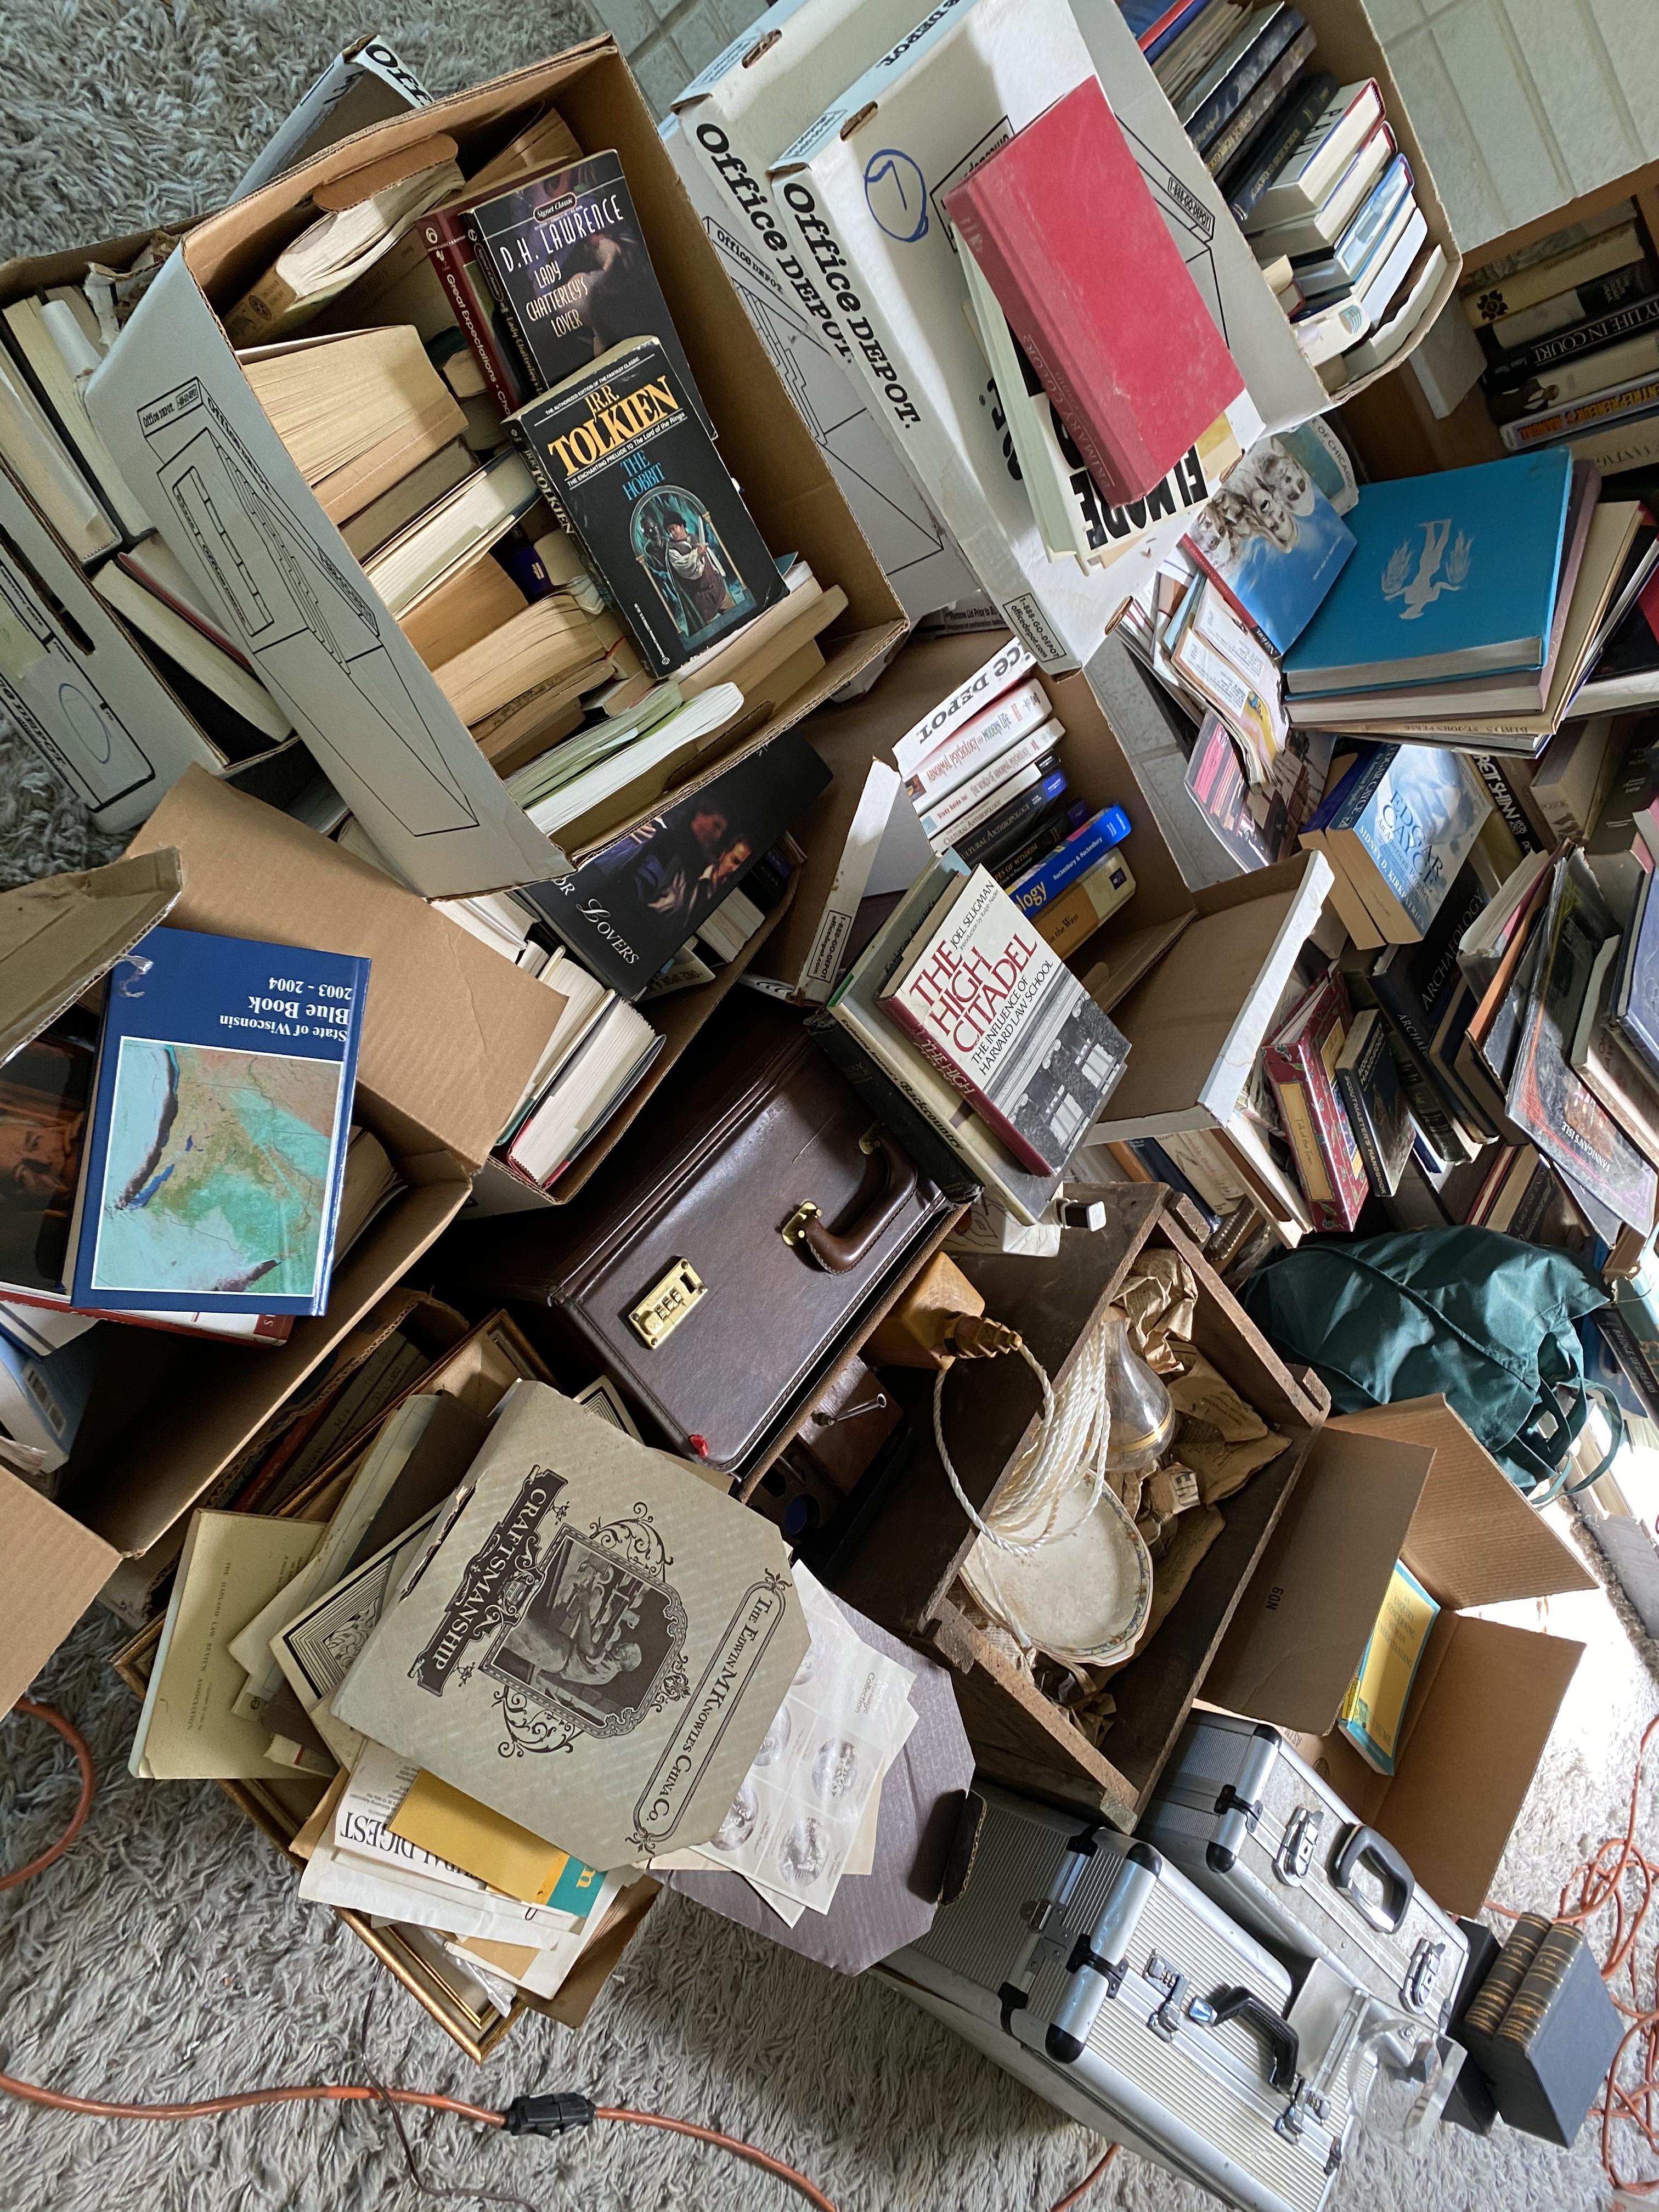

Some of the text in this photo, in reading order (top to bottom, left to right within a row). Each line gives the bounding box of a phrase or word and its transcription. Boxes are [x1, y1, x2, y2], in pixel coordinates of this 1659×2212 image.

[365, 44, 432, 106] Off
[537, 197, 573, 218] Signet Classic
[1169, 179, 1211, 228] 1-888-GO-DEPOT
[500, 194, 624, 272] D.H. LAWRENCE
[696, 122, 788, 253] Office
[776, 255, 853, 364] DEPOT.
[716, 229, 752, 266] Office
[526, 276, 589, 322] CHATTERLEY'S
[534, 261, 562, 289] LADY
[447, 274, 497, 383] Great Expectations
[506, 316, 520, 338] Lady
[551, 308, 583, 338] LOVER
[783, 182, 862, 313] Office
[847, 315, 921, 431] DEPOT.
[1535, 311, 1644, 363] LIFE IN COURT
[554, 393, 579, 411] AUTHORIZED
[578, 385, 594, 397] EDITION
[592, 380, 599, 388] OF
[598, 376, 606, 385] THE
[606, 365, 625, 381] FANTASY
[623, 356, 640, 370] CLASSIC
[142, 411, 160, 428] Office
[547, 375, 680, 477] TOLKIEN
[1022, 334, 1111, 489] PRIMARY COLORS
[1520, 411, 1566, 440] MANUAL
[567, 412, 686, 488] THE ENCHANTING PRELUDE TO The Lord of the Rings
[620, 449, 650, 477] THE
[1318, 426, 1353, 489] OF CHICAGO
[532, 466, 574, 534] TOLKIEN
[622, 462, 666, 501] HOBBIT
[1011, 605, 1048, 658] officedepot.com
[1020, 597, 1060, 658] 1-888-GO-DEPOT
[926, 753, 953, 785] ABNORMAL
[951, 736, 980, 768] PSYCHOLOGY
[983, 723, 1003, 742] MODERN
[1000, 712, 1012, 730] LIFE
[938, 808, 950, 819] Study
[950, 798, 962, 811] Guide
[943, 820, 969, 846] CULTURAL
[967, 799, 1002, 829] ANTHROPOLOGY
[988, 802, 1031, 842] ANTHROPOLOGY
[1355, 780, 1376, 815] CAYCE
[1014, 843, 1039, 865] WISDOM
[1052, 860, 1077, 881] Hockenbury
[1079, 837, 1103, 859] Hockenbury
[1377, 818, 1430, 900] An American Prophet
[1383, 804, 1438, 892] CAYCE
[1389, 789, 1443, 877] EDGAR
[1359, 825, 1426, 932] SIDNEY D. KIRKPATRICK
[575, 898, 640, 964] LOVERS
[950, 880, 994, 949] JOEL SELIGMAN
[960, 889, 999, 951] Introduction by Ralph Nader
[1048, 913, 1080, 943] in the West
[812, 915, 837, 974] officedepot.com
[821, 916, 847, 980] 1-888-GO-DEPOT
[1421, 888, 1485, 1012] ARCHAEOLOGY
[269, 977, 353, 1000] 2003 2004
[663, 972, 685, 985] UPON
[909, 939, 963, 1007] THE
[929, 945, 993, 1036] HIGH
[952, 932, 1038, 1053] CITADEL
[219, 1014, 348, 1042] State of Wisconsin
[247, 995, 352, 1025] Blue Book
[971, 974, 1028, 1065] THE INFLUENCE OF
[979, 959, 1054, 1076] HARVARD LAW SCHOOL
[841, 1018, 964, 1150] Exploring America's Backcountry
[922, 1039, 946, 1065] THE
[942, 1061, 976, 1095] HIGH
[1344, 1075, 1387, 1195] SCOUTMASTER'S HANDBOOK
[1561, 1121, 1611, 1173] FANNIGAN'S ISLE
[1612, 1329, 1634, 1355] BRIDGE
[1629, 1355, 1640, 1368] OF
[223, 1561, 231, 1576] THE
[431, 1488, 547, 1671] CRAFTSMANSHIP
[213, 1582, 227, 1617] HARVARD
[1386, 1601, 1417, 1640] CONCERNING
[208, 1621, 218, 1638] LAW
[1376, 1620, 1413, 1669] UNDERSTANDING
[1388, 1618, 1407, 1644] HUMAN
[200, 1643, 212, 1672] REVIEW
[186, 1678, 203, 1731] ASSOCIATION
[854, 1672, 875, 1714] Collection
[1378, 1724, 1392, 1748] HUME
